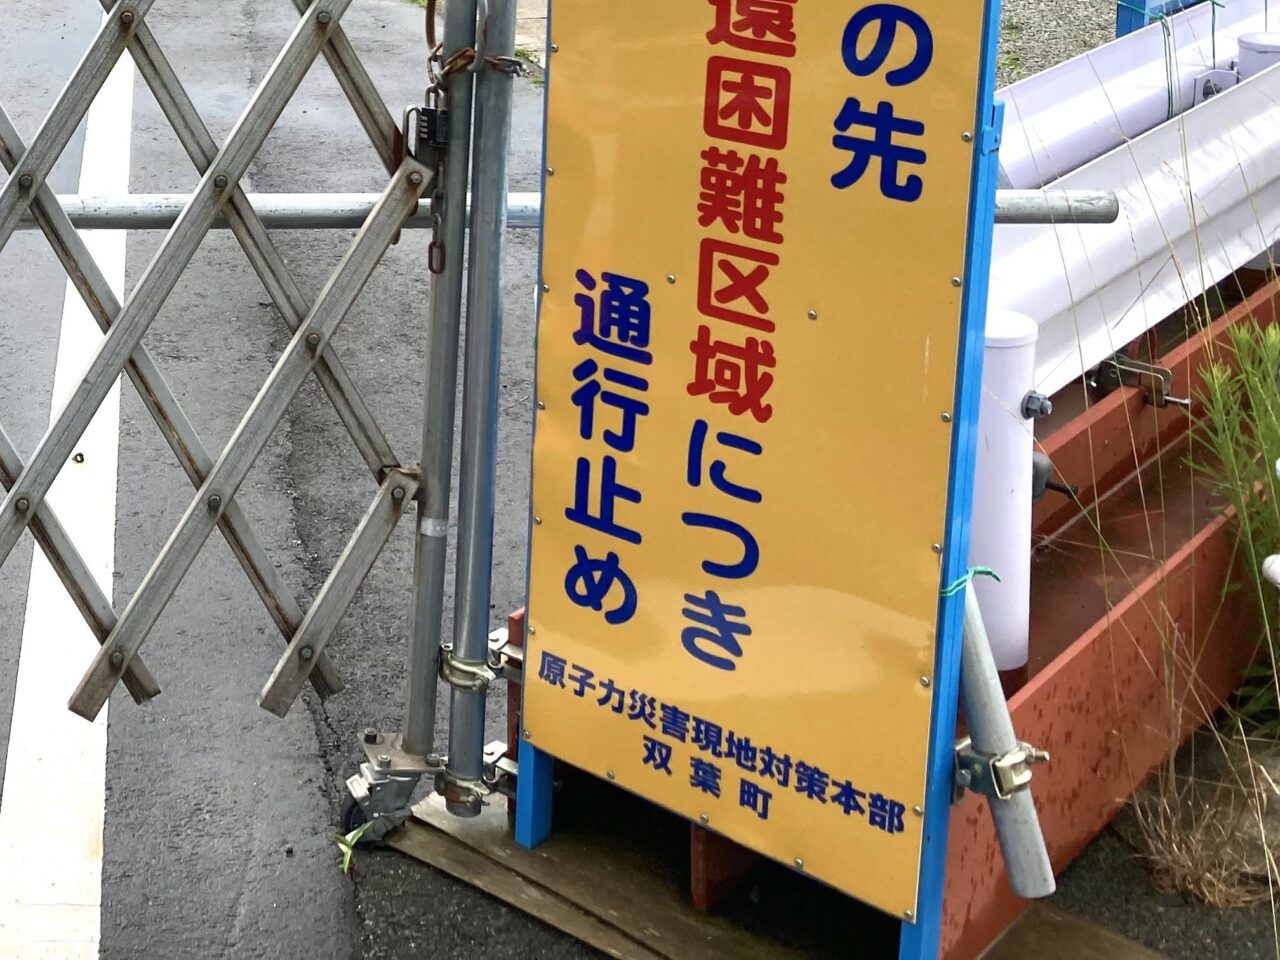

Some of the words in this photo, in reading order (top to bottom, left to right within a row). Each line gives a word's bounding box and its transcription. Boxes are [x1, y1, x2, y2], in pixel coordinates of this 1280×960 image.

[564, 269, 653, 625] 通行止め
[538, 650, 907, 836] 原子力災害現地対策本部
[642, 734, 773, 822] 双葉町
